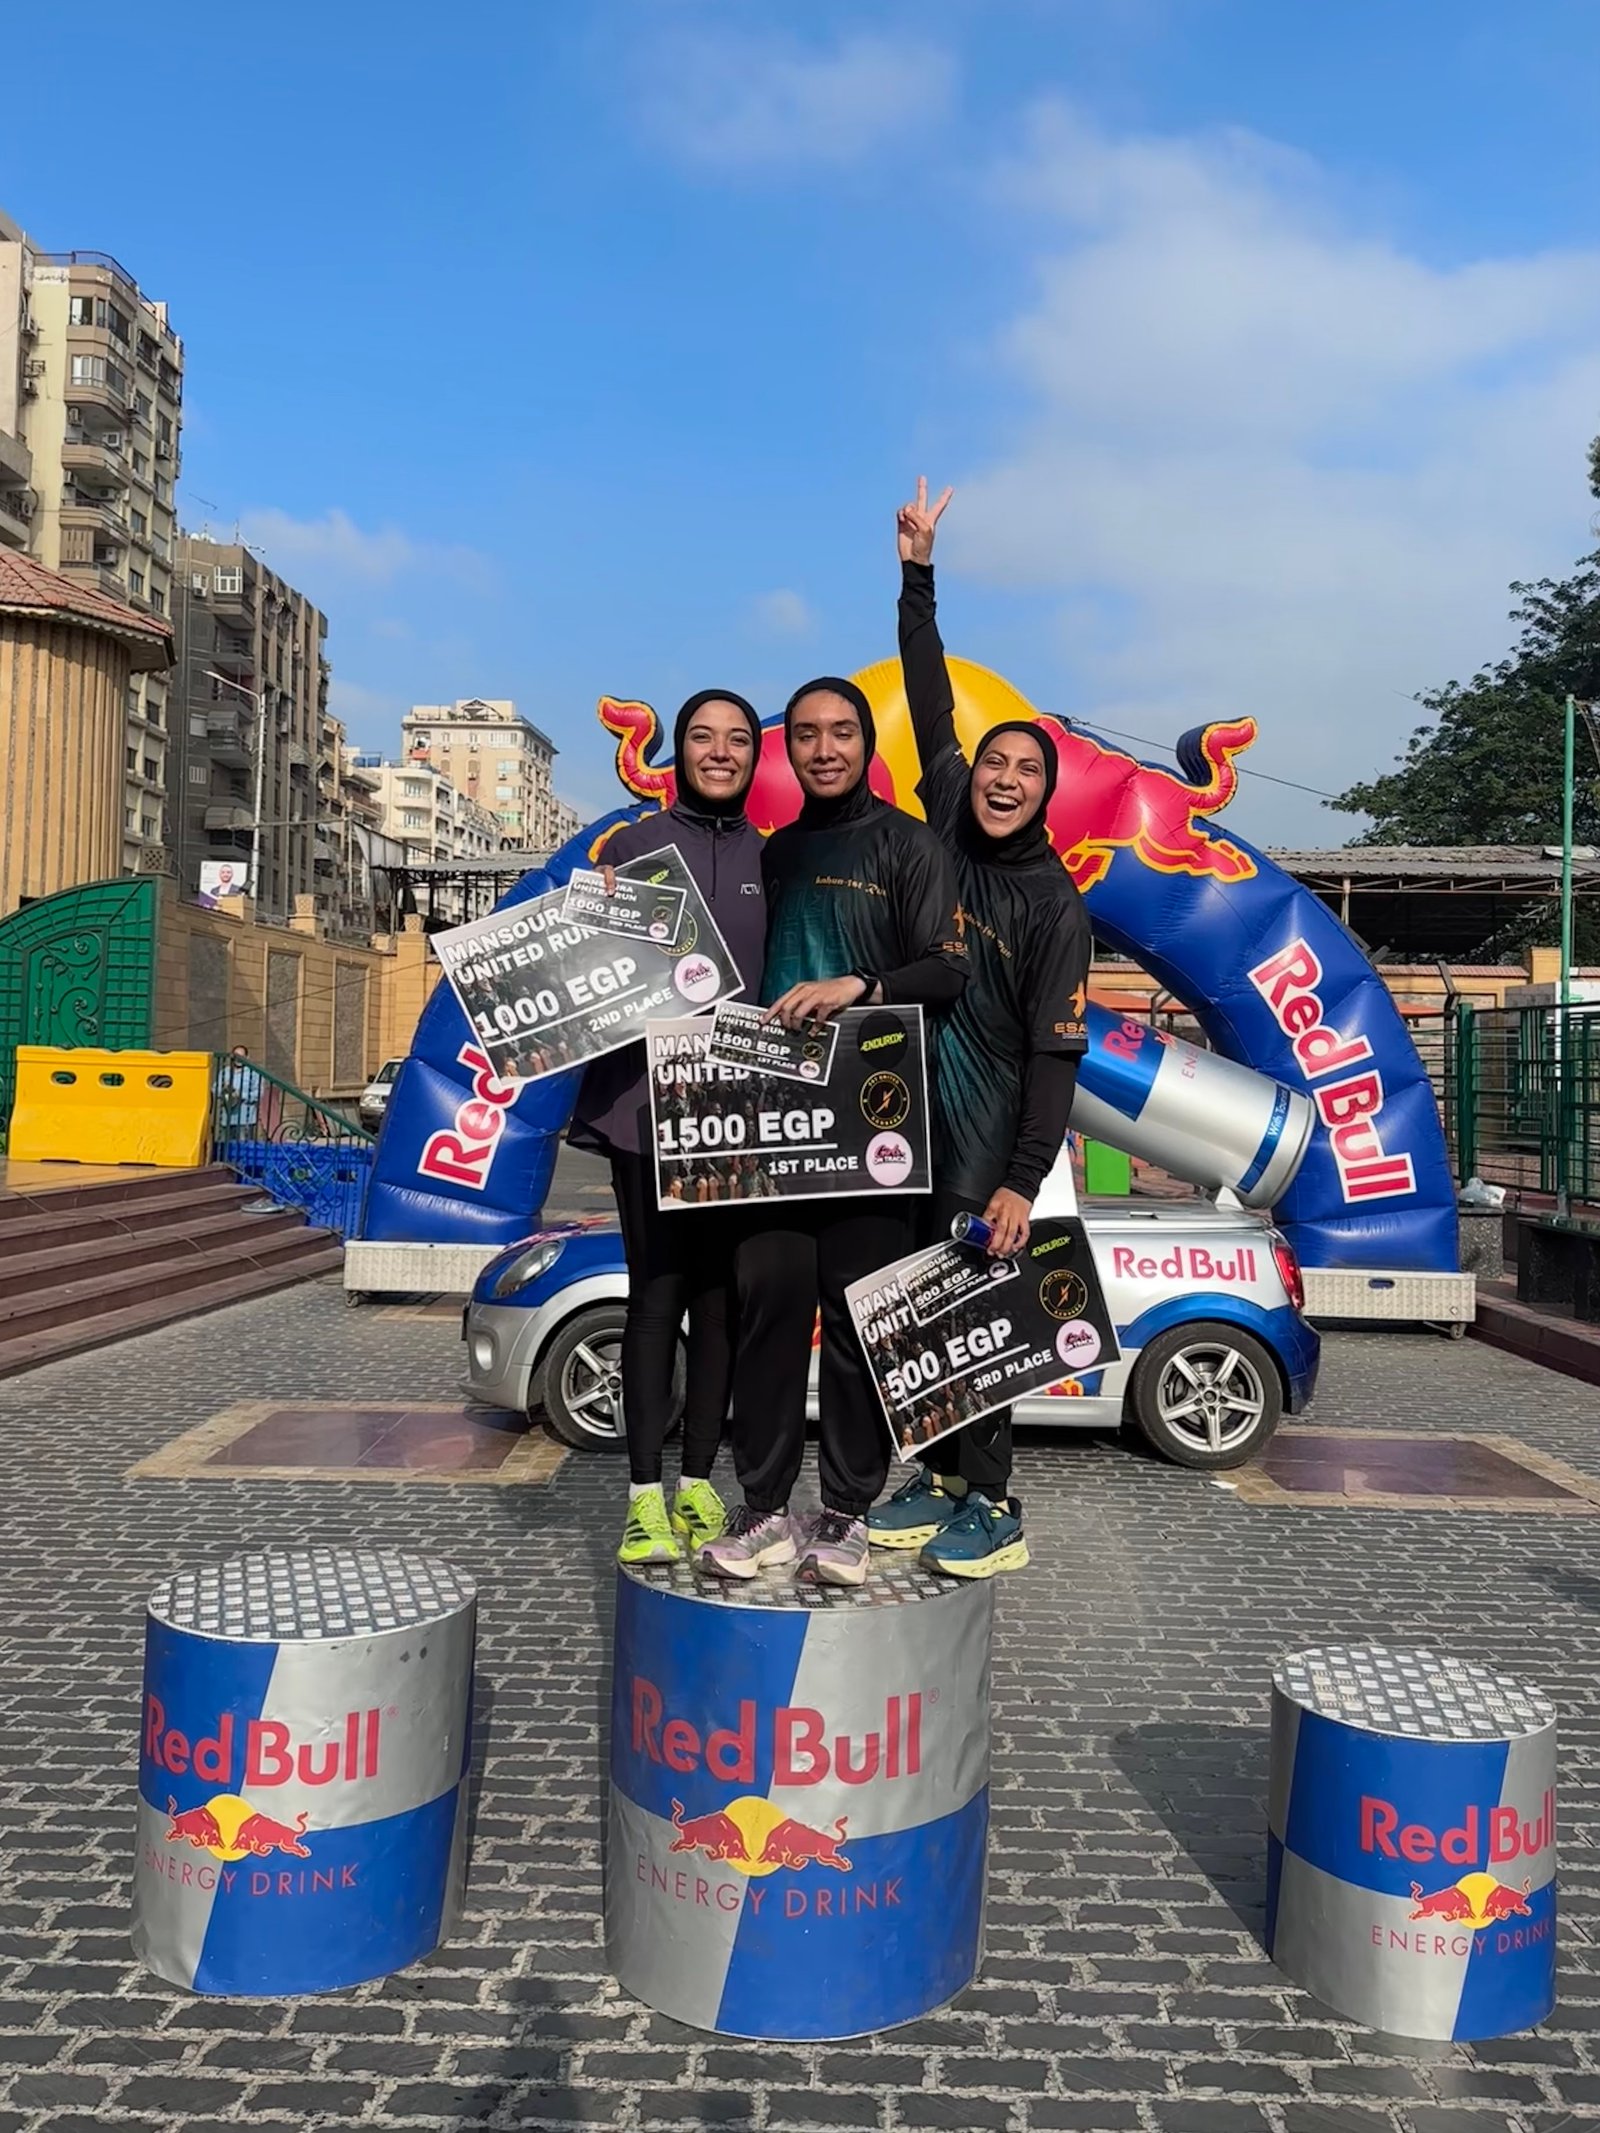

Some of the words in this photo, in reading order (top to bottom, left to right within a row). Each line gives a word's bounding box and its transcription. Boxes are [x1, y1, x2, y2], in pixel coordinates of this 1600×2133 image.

[569, 897, 605, 913] 1000
[609, 905, 642, 920] EGP
[573, 882, 610, 897] UNITE
[444, 907, 563, 963] MANSOUR
[454, 942, 545, 985] UNITED
[474, 988, 560, 1039] 1000
[564, 955, 639, 1007] EGP
[588, 1010, 622, 1033] 2ND
[623, 986, 674, 1018] PLACE
[713, 1031, 752, 1048] 1500
[756, 1040, 791, 1056] EGP
[718, 1015, 760, 1031] UNITED
[1250, 940, 1371, 1077] Red
[1316, 1073, 1413, 1200] Bull
[658, 1113, 746, 1149] 1500
[758, 1108, 836, 1142] EGP
[768, 1159, 800, 1175] 1ST
[803, 1155, 859, 1173] PLACE
[1113, 1246, 1184, 1279] Red
[1188, 1248, 1257, 1282] Bull
[914, 1285, 940, 1307] 500
[942, 1267, 972, 1290] EGP
[863, 1304, 910, 1345] UNIT
[885, 1350, 940, 1400] 500
[945, 1317, 1013, 1369] EGP
[972, 1371, 1003, 1392] 3RD
[1004, 1348, 1054, 1379] PLACE
[146, 1694, 234, 1784] Red
[245, 1708, 381, 1787] Bull
[632, 1676, 757, 1784] Red
[773, 1691, 922, 1787] Bull
[1360, 1795, 1479, 1865] Red
[1488, 1785, 1555, 1864] Bull
[143, 1843, 238, 1895] ENERGY
[252, 1863, 360, 1895] DRINK
[636, 1853, 768, 1916] ENERGY
[784, 1877, 905, 1918] DRINK
[1371, 1924, 1487, 1957] ENERGY
